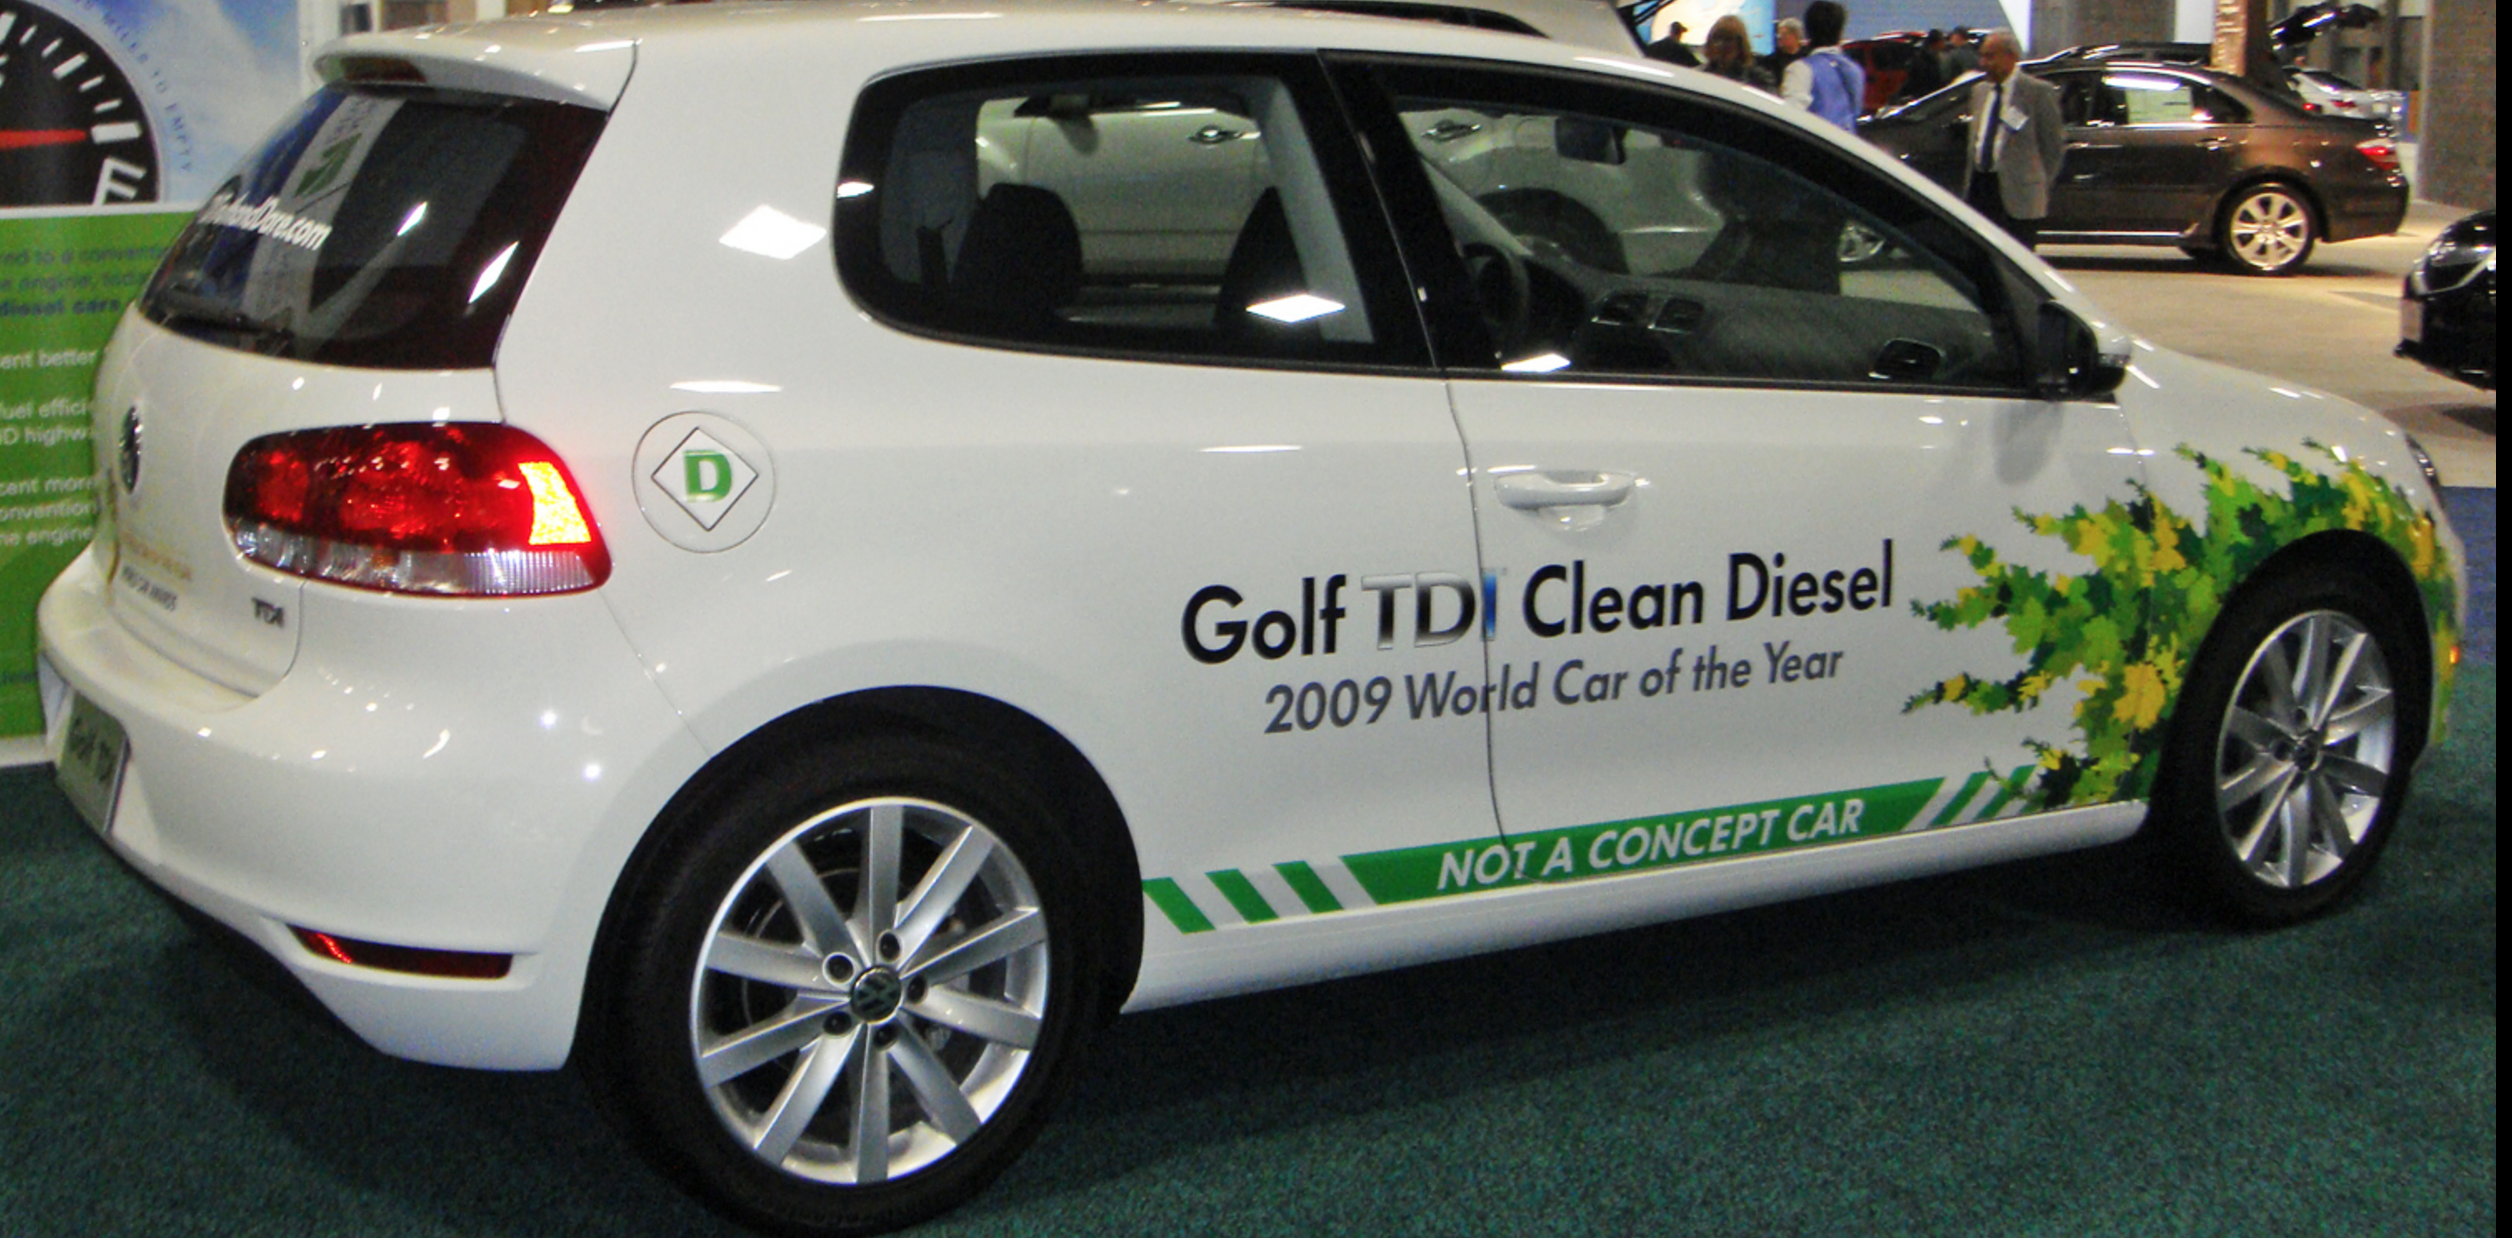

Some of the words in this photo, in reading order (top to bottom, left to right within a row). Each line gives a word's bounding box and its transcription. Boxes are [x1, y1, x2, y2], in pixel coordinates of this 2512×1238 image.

[165, 102, 193, 171] EMPTY
[0, 352, 33, 369] ent
[38, 347, 96, 367] better
[25, 424, 88, 447] highw
[38, 398, 88, 418] effici
[683, 450, 733, 503] D
[1181, 574, 1346, 665] Golf
[1361, 567, 1497, 653] TDI
[1521, 560, 1705, 637] Clean
[1725, 539, 1894, 621] Diesel
[1264, 675, 1393, 734] 2009
[1404, 662, 1538, 720] World
[1553, 659, 1628, 706] Car
[1638, 645, 1682, 696] of
[1692, 645, 1753, 692] the
[1763, 636, 1844, 685] Year
[1437, 843, 1536, 891] NOT
[1542, 837, 1574, 876] A
[1588, 809, 1780, 868] CONCEPT
[1786, 799, 1865, 841] CAR
